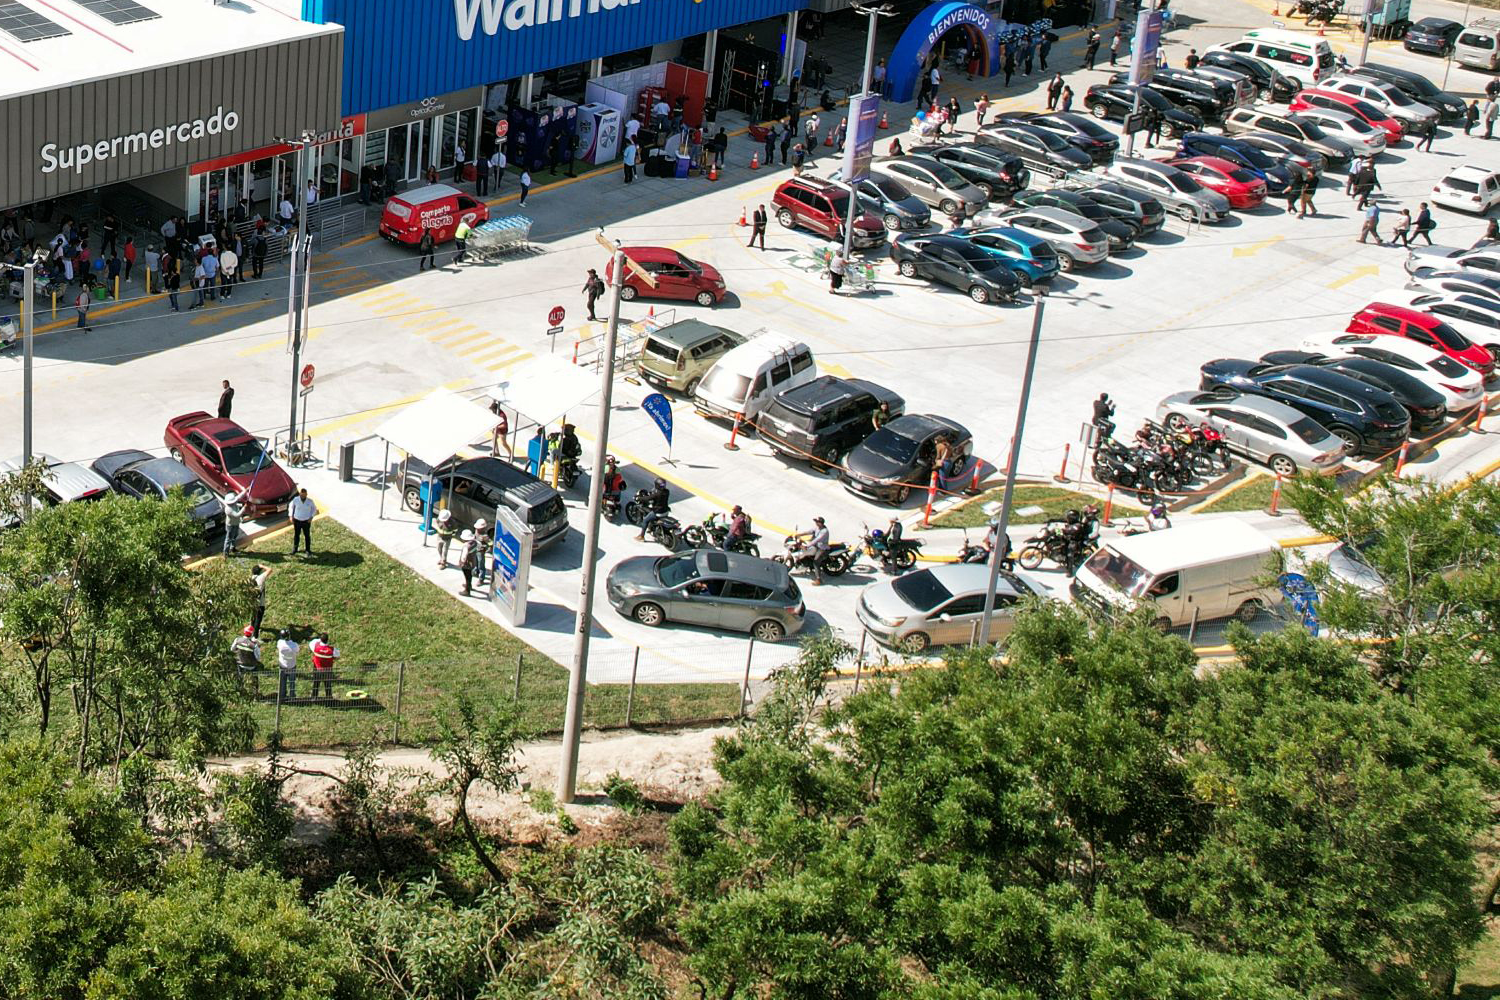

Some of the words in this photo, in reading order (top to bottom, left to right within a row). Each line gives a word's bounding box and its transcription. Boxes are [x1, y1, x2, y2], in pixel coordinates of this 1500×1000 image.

[928, 8, 990, 44] BIENVENIDOS
[41, 106, 239, 174] Supermercado
[420, 205, 451, 218] Comparte
[421, 216, 453, 230] alegría
[549, 311, 563, 322] ALTO
